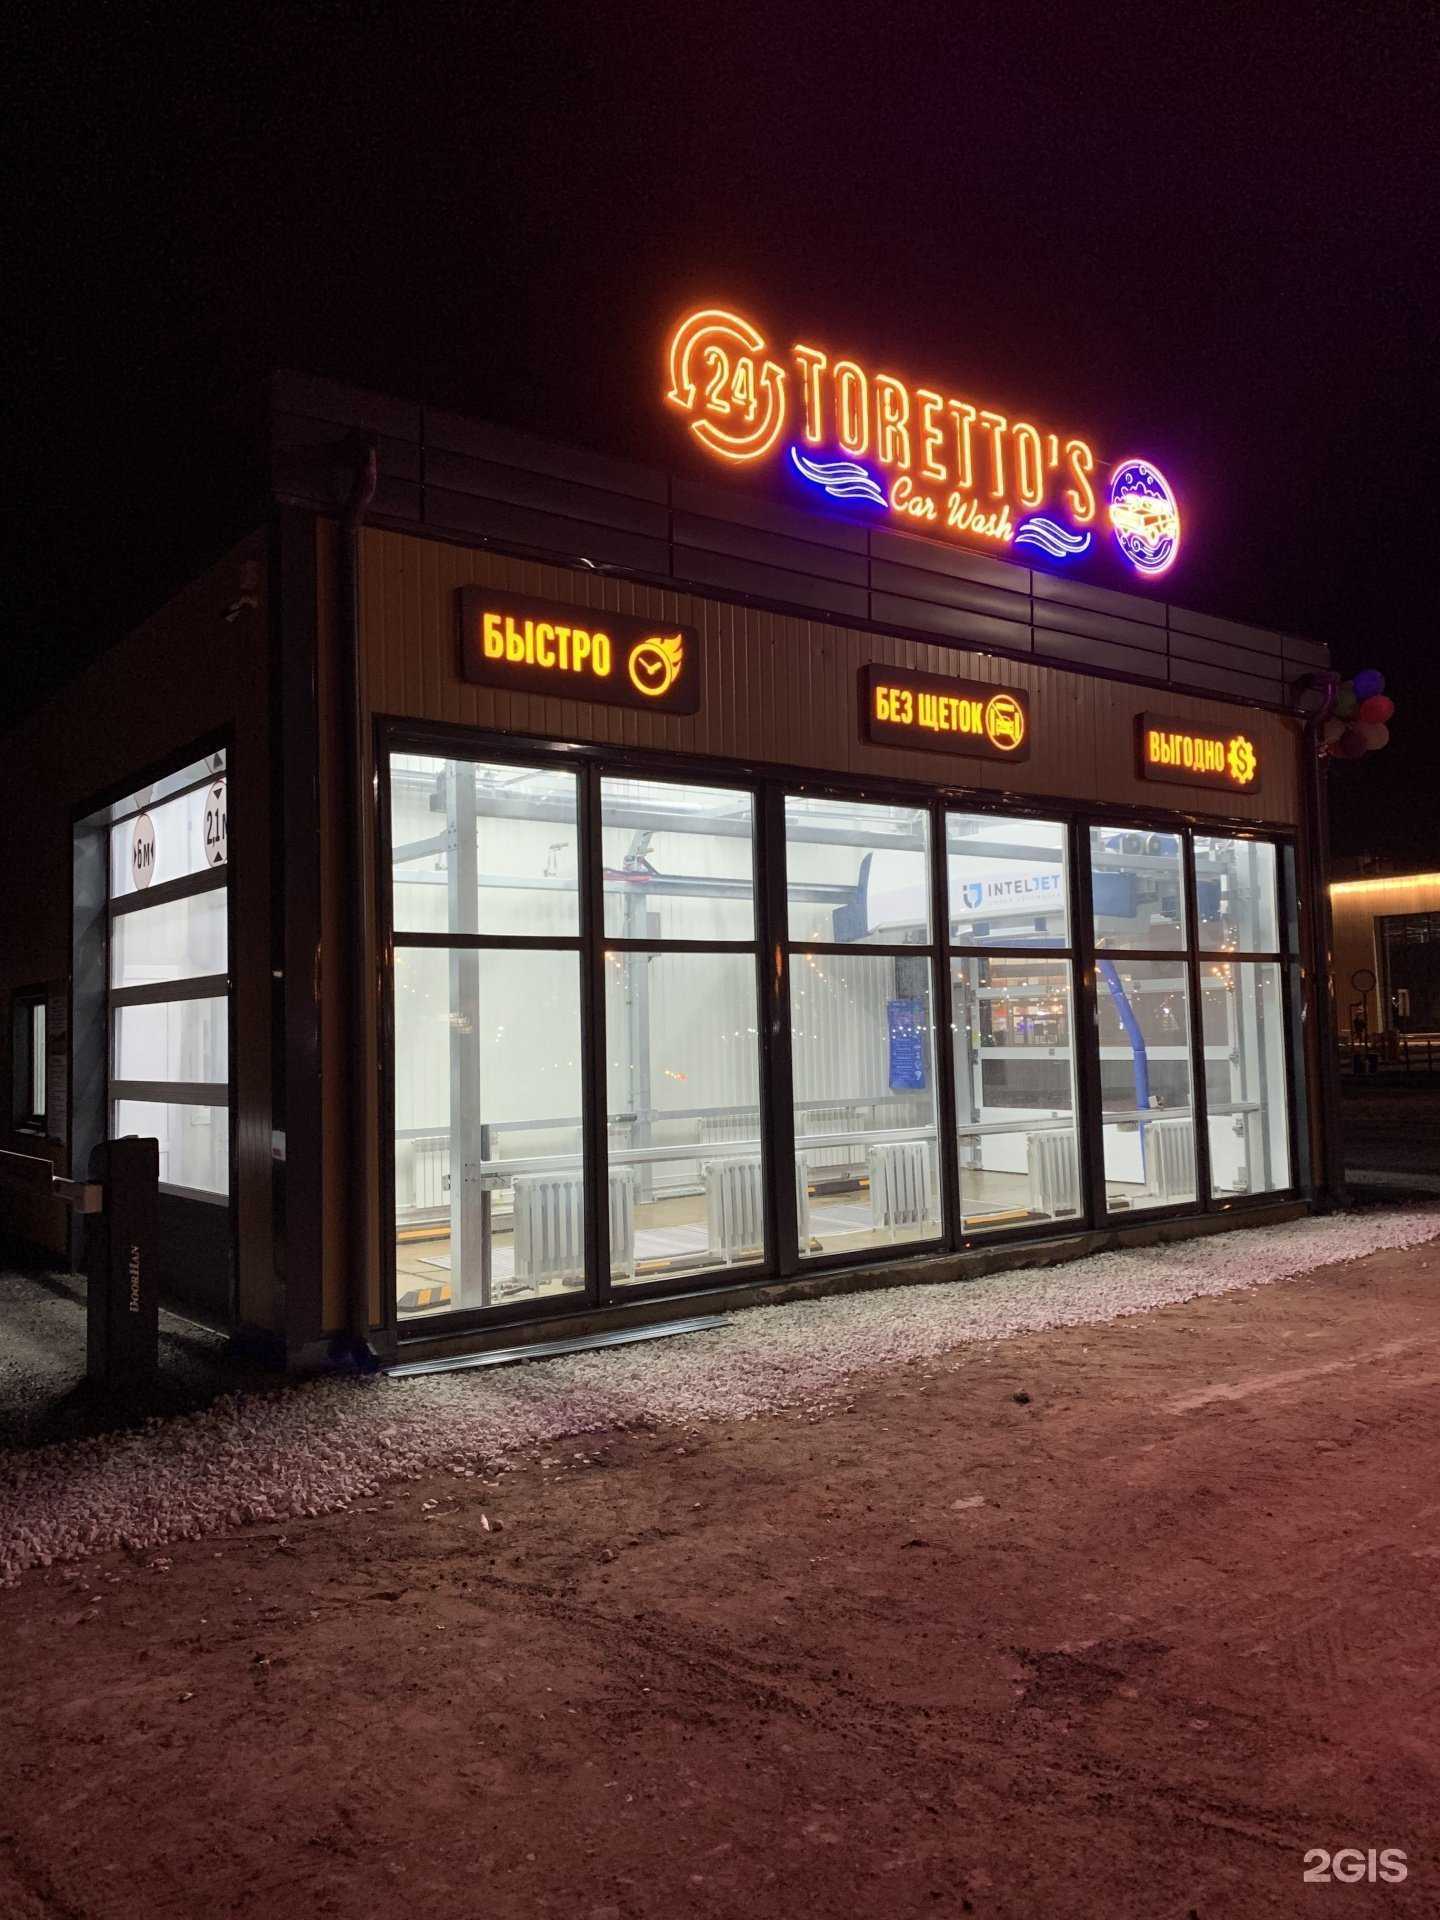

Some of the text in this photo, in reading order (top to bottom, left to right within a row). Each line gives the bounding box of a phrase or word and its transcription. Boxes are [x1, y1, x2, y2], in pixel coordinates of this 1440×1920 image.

[703, 345, 757, 421] 24
[794, 344, 1096, 522] TORETTO'S
[890, 475, 1014, 542] Car Wash
[483, 612, 611, 677] БЫСТРО
[876, 686, 984, 734] БЕЗ ЩЕТОК
[1149, 730, 1225, 773] ВЫГОДНО
[988, 874, 1060, 897] INTELJET
